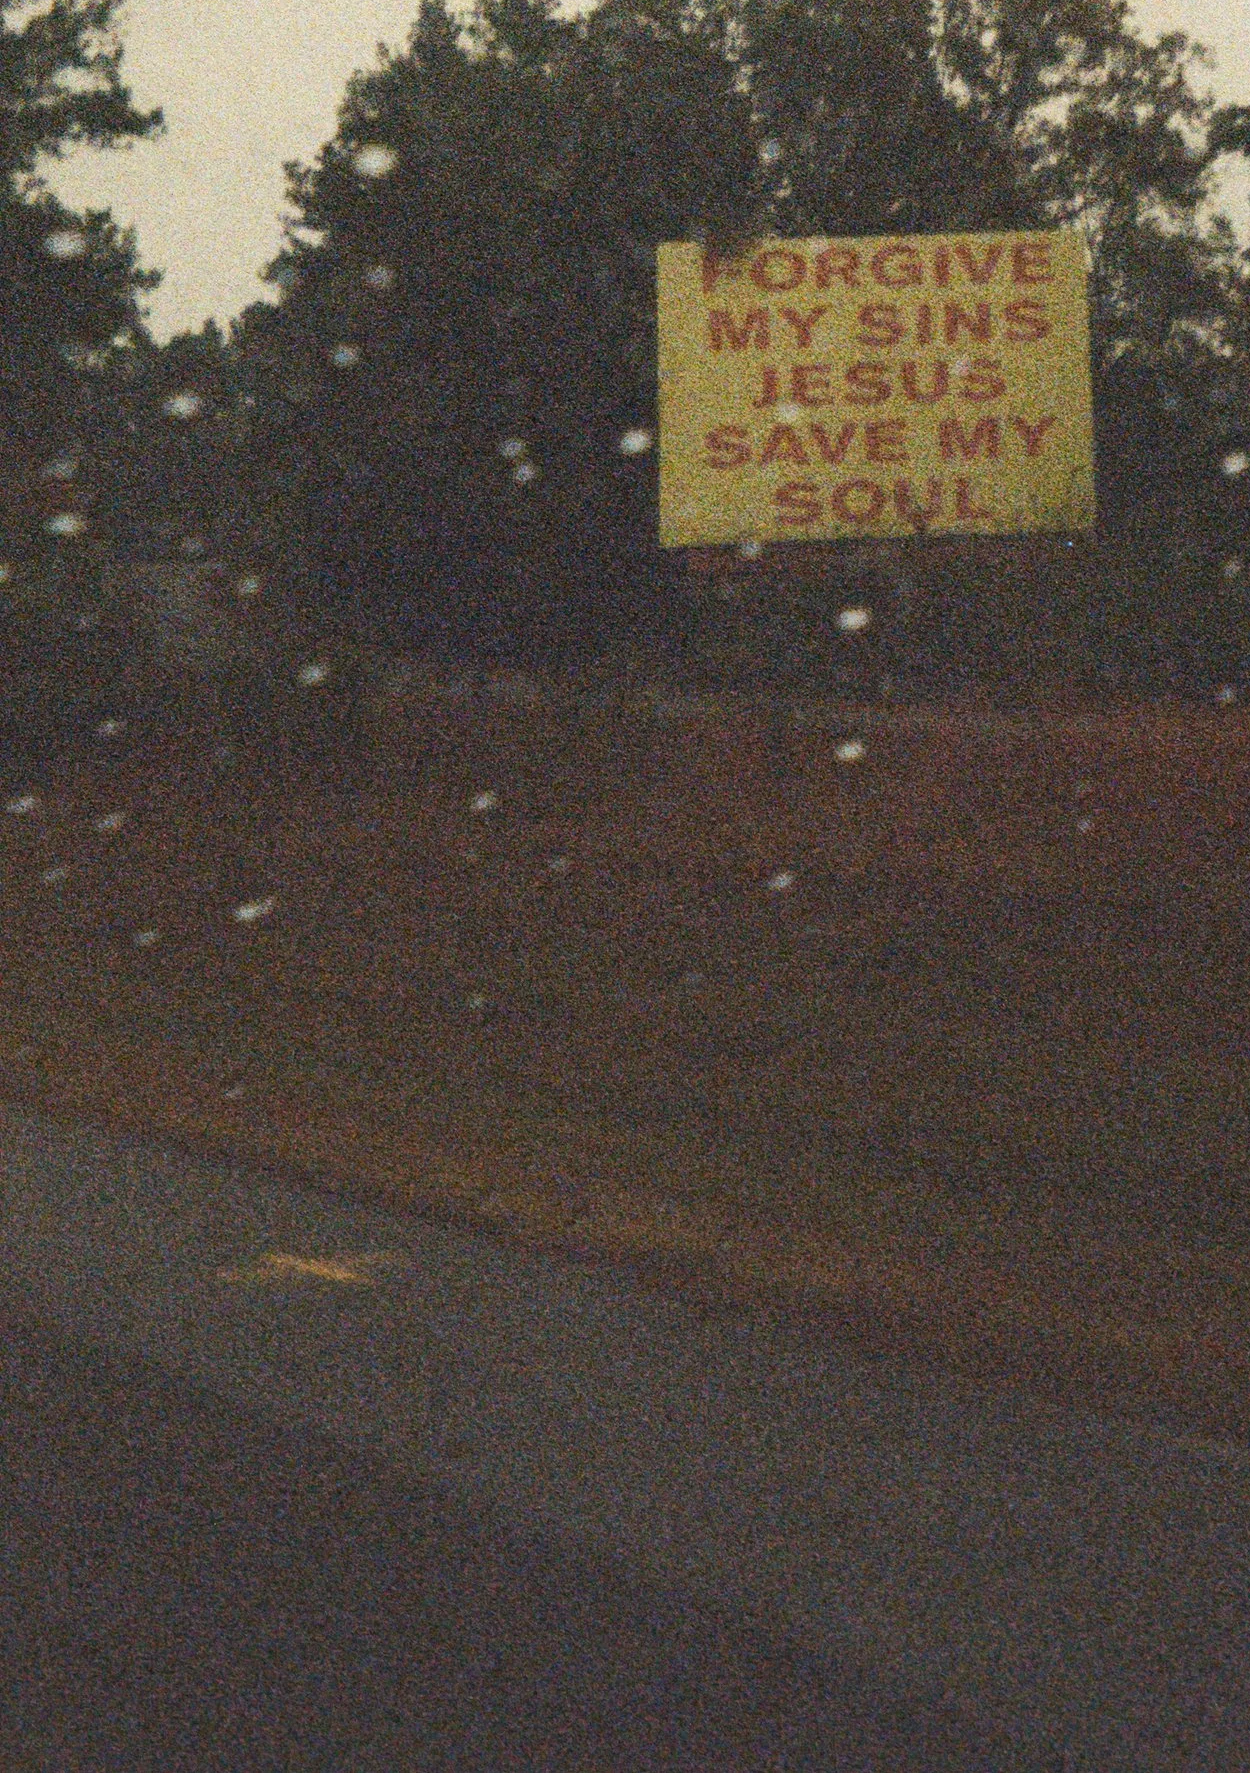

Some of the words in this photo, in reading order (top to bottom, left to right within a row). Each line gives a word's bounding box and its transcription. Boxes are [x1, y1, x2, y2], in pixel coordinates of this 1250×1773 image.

[707, 306, 826, 350] MY
[858, 300, 1051, 346] SINS
[754, 359, 1006, 408] JESUS
[704, 419, 907, 470] SAVE
[939, 417, 1055, 460] MY
[774, 478, 991, 526] SOUL
